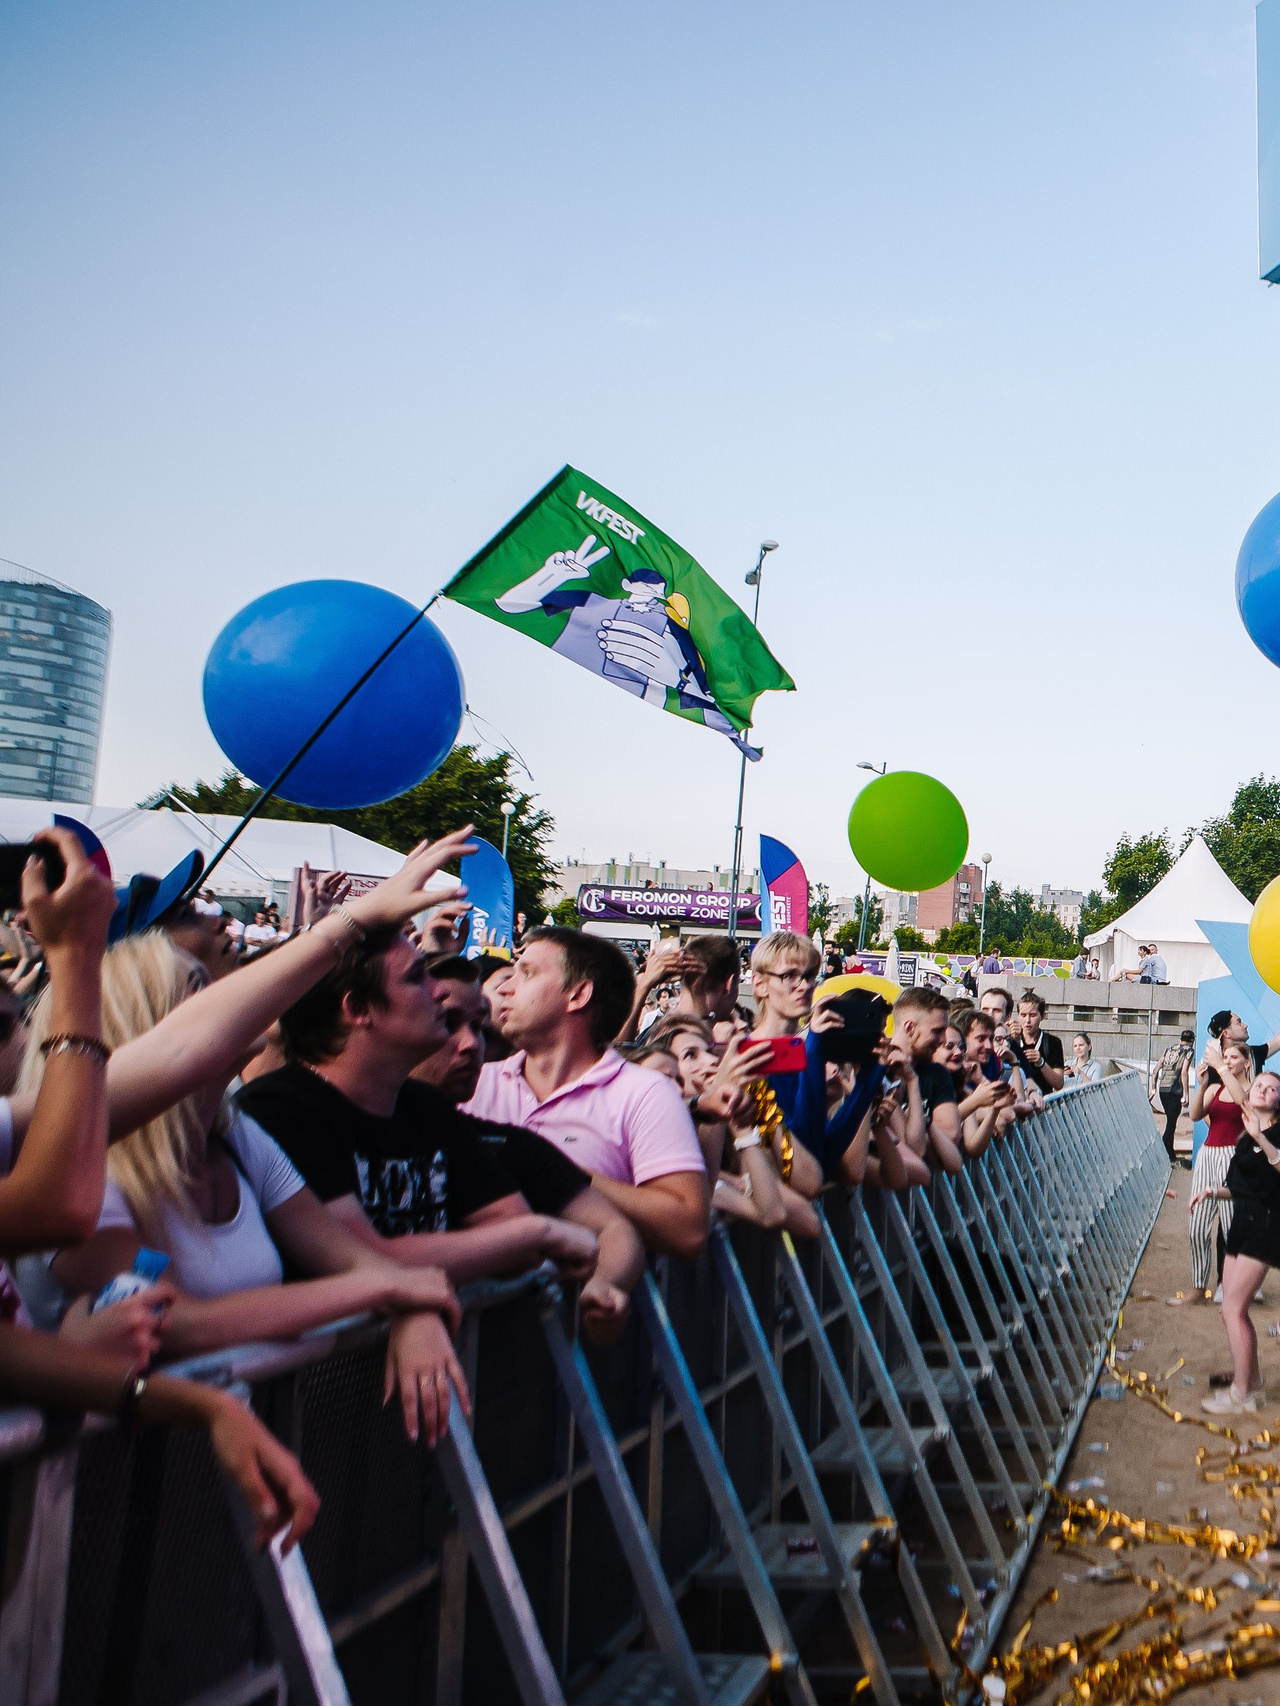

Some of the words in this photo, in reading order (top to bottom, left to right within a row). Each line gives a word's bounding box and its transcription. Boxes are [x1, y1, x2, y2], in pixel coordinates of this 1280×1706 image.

[576, 489, 646, 546] VKFEST
[610, 889, 693, 905] FEROMON
[626, 903, 687, 917] LOUNGE
[690, 906, 730, 920] ZONE
[770, 891, 787, 932] FEST
